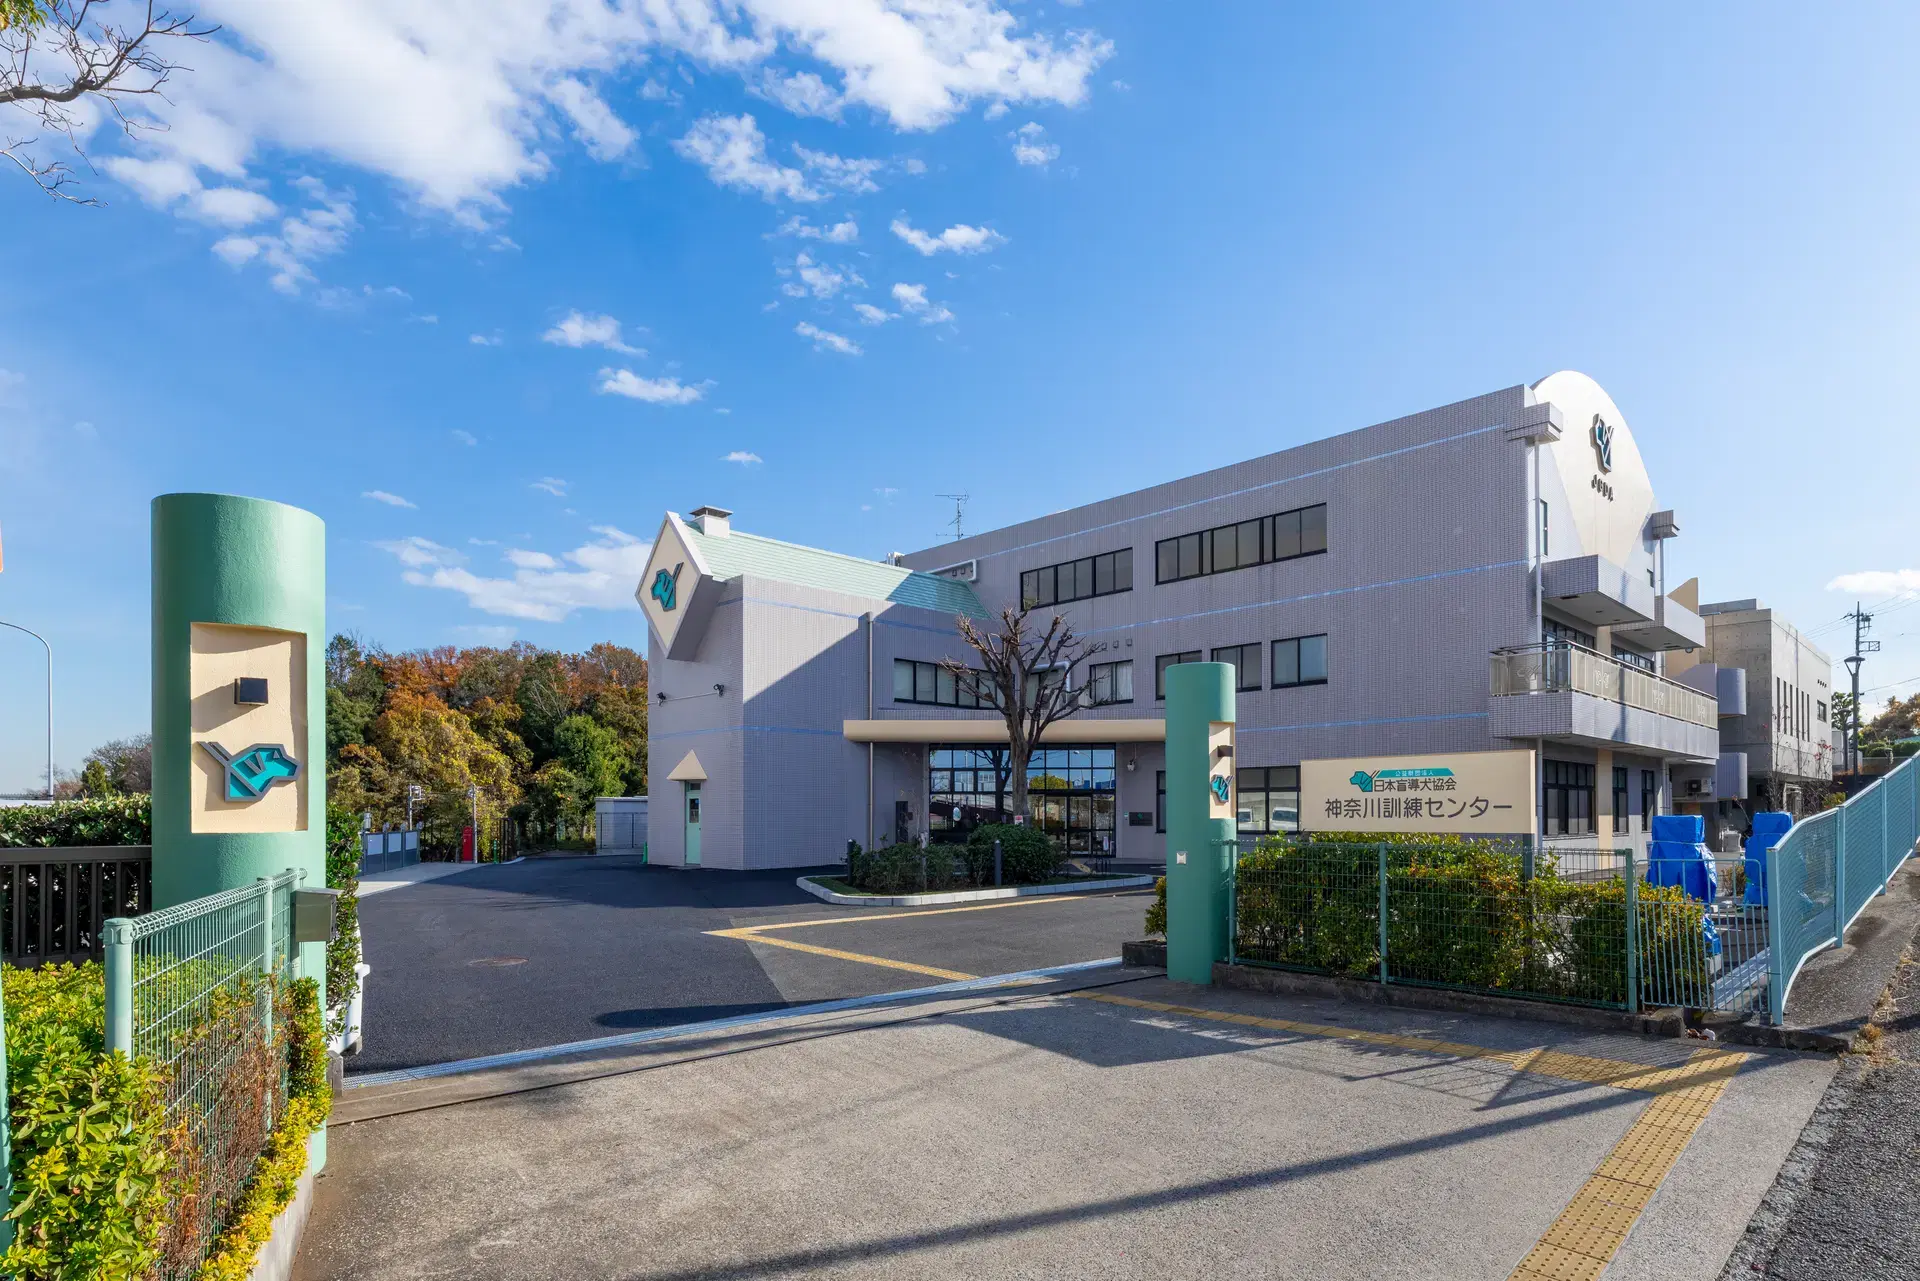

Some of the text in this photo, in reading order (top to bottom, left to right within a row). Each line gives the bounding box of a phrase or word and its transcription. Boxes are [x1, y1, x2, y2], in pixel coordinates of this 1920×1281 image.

[1374, 777, 1457, 792] 日本盲導犬協会
[1325, 796, 1512, 819] 神奈川訓練センター
